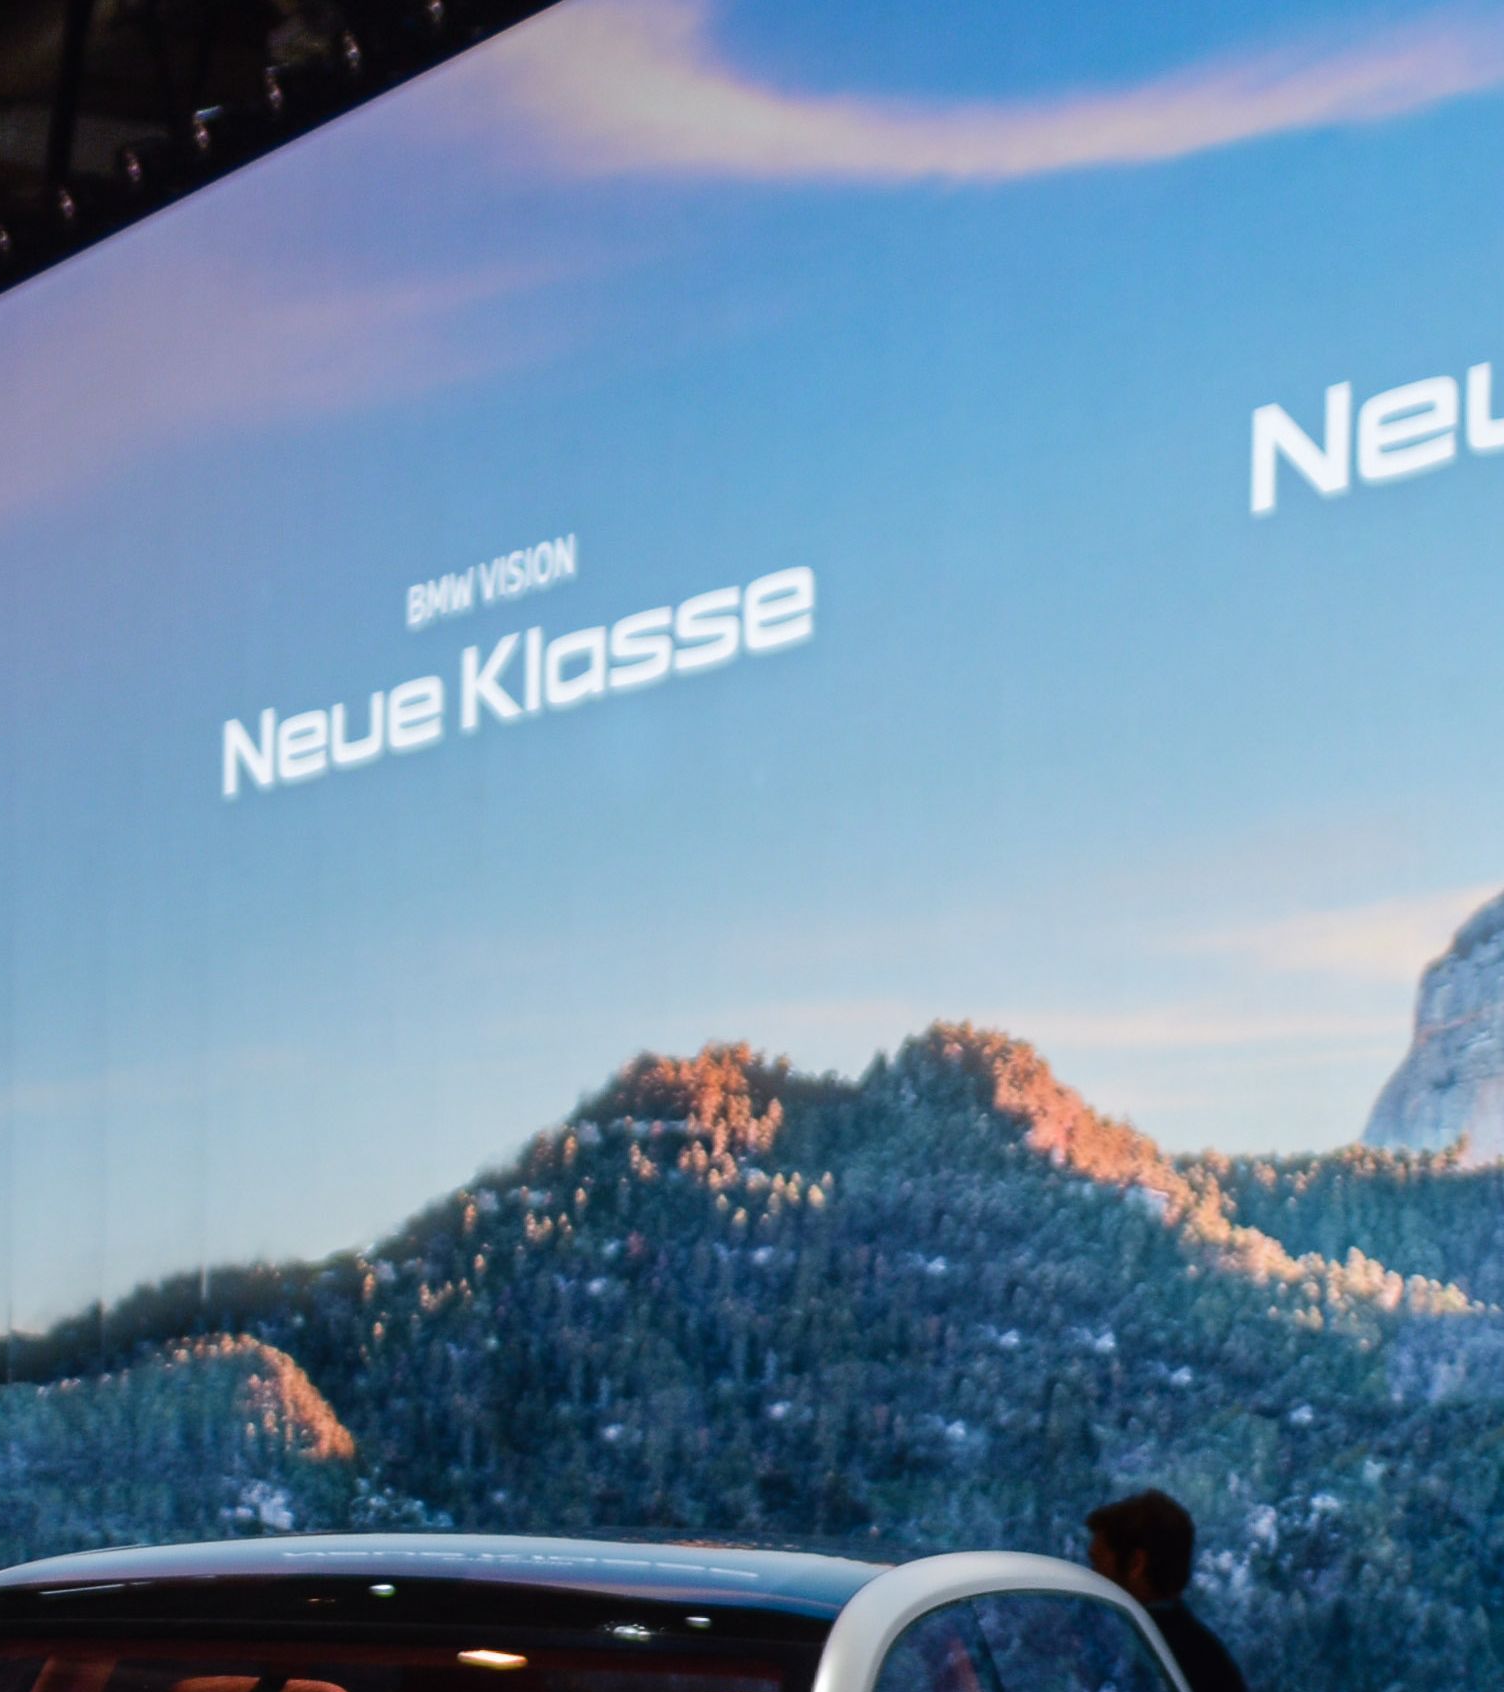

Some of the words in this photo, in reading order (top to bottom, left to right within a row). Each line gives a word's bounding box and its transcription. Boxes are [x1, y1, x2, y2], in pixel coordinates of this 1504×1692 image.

[406, 565, 473, 628] BMW
[479, 532, 576, 602] VISION
[223, 674, 444, 797] Neue
[460, 565, 815, 733] Klasse
